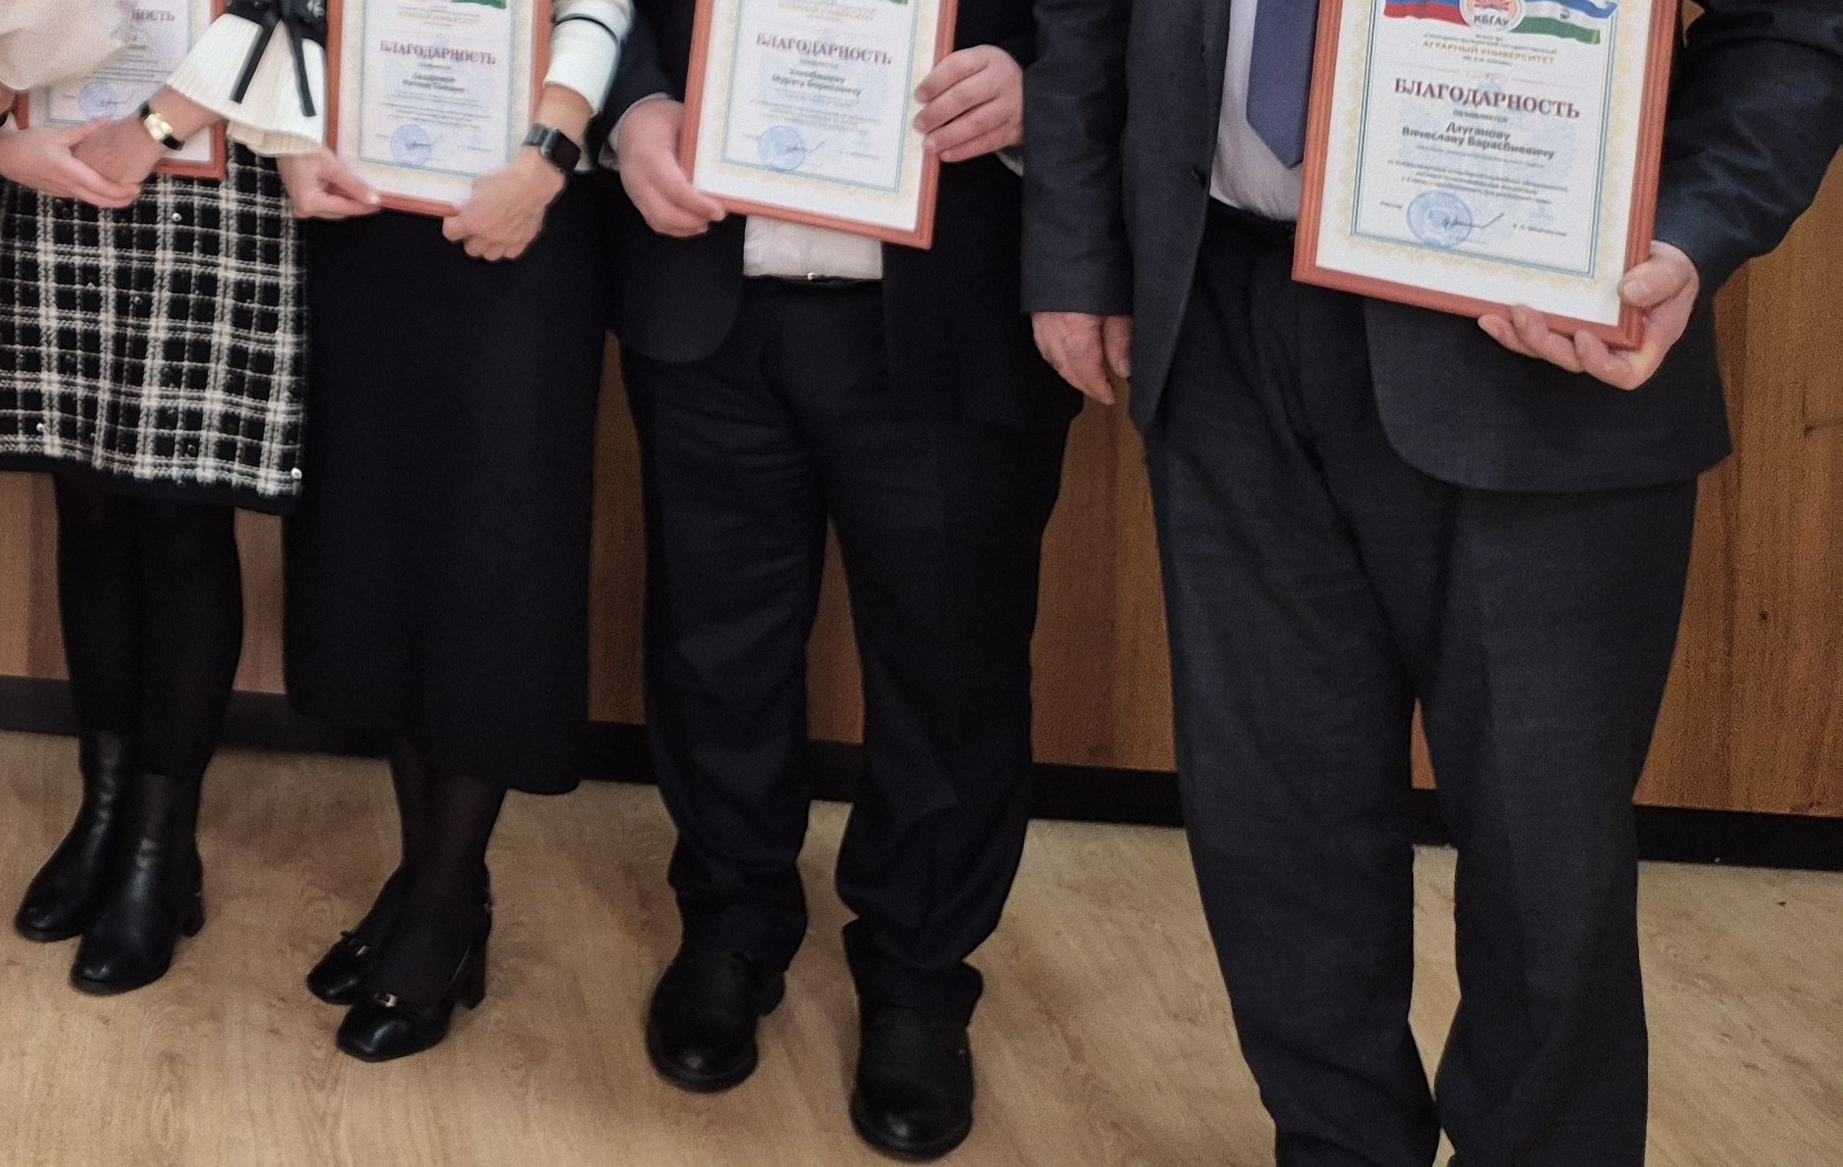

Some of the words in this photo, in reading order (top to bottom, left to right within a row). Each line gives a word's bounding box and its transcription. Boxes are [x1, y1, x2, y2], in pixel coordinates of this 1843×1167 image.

[1473, 13, 1510, 27] КБГАУ
[380, 40, 496, 65] БЛАГОДАРНОСТЬ
[756, 33, 892, 65] БЛАГОДАРНОСТЬ
[1394, 78, 1580, 119] БЛАГОДАРНОСТЬ
